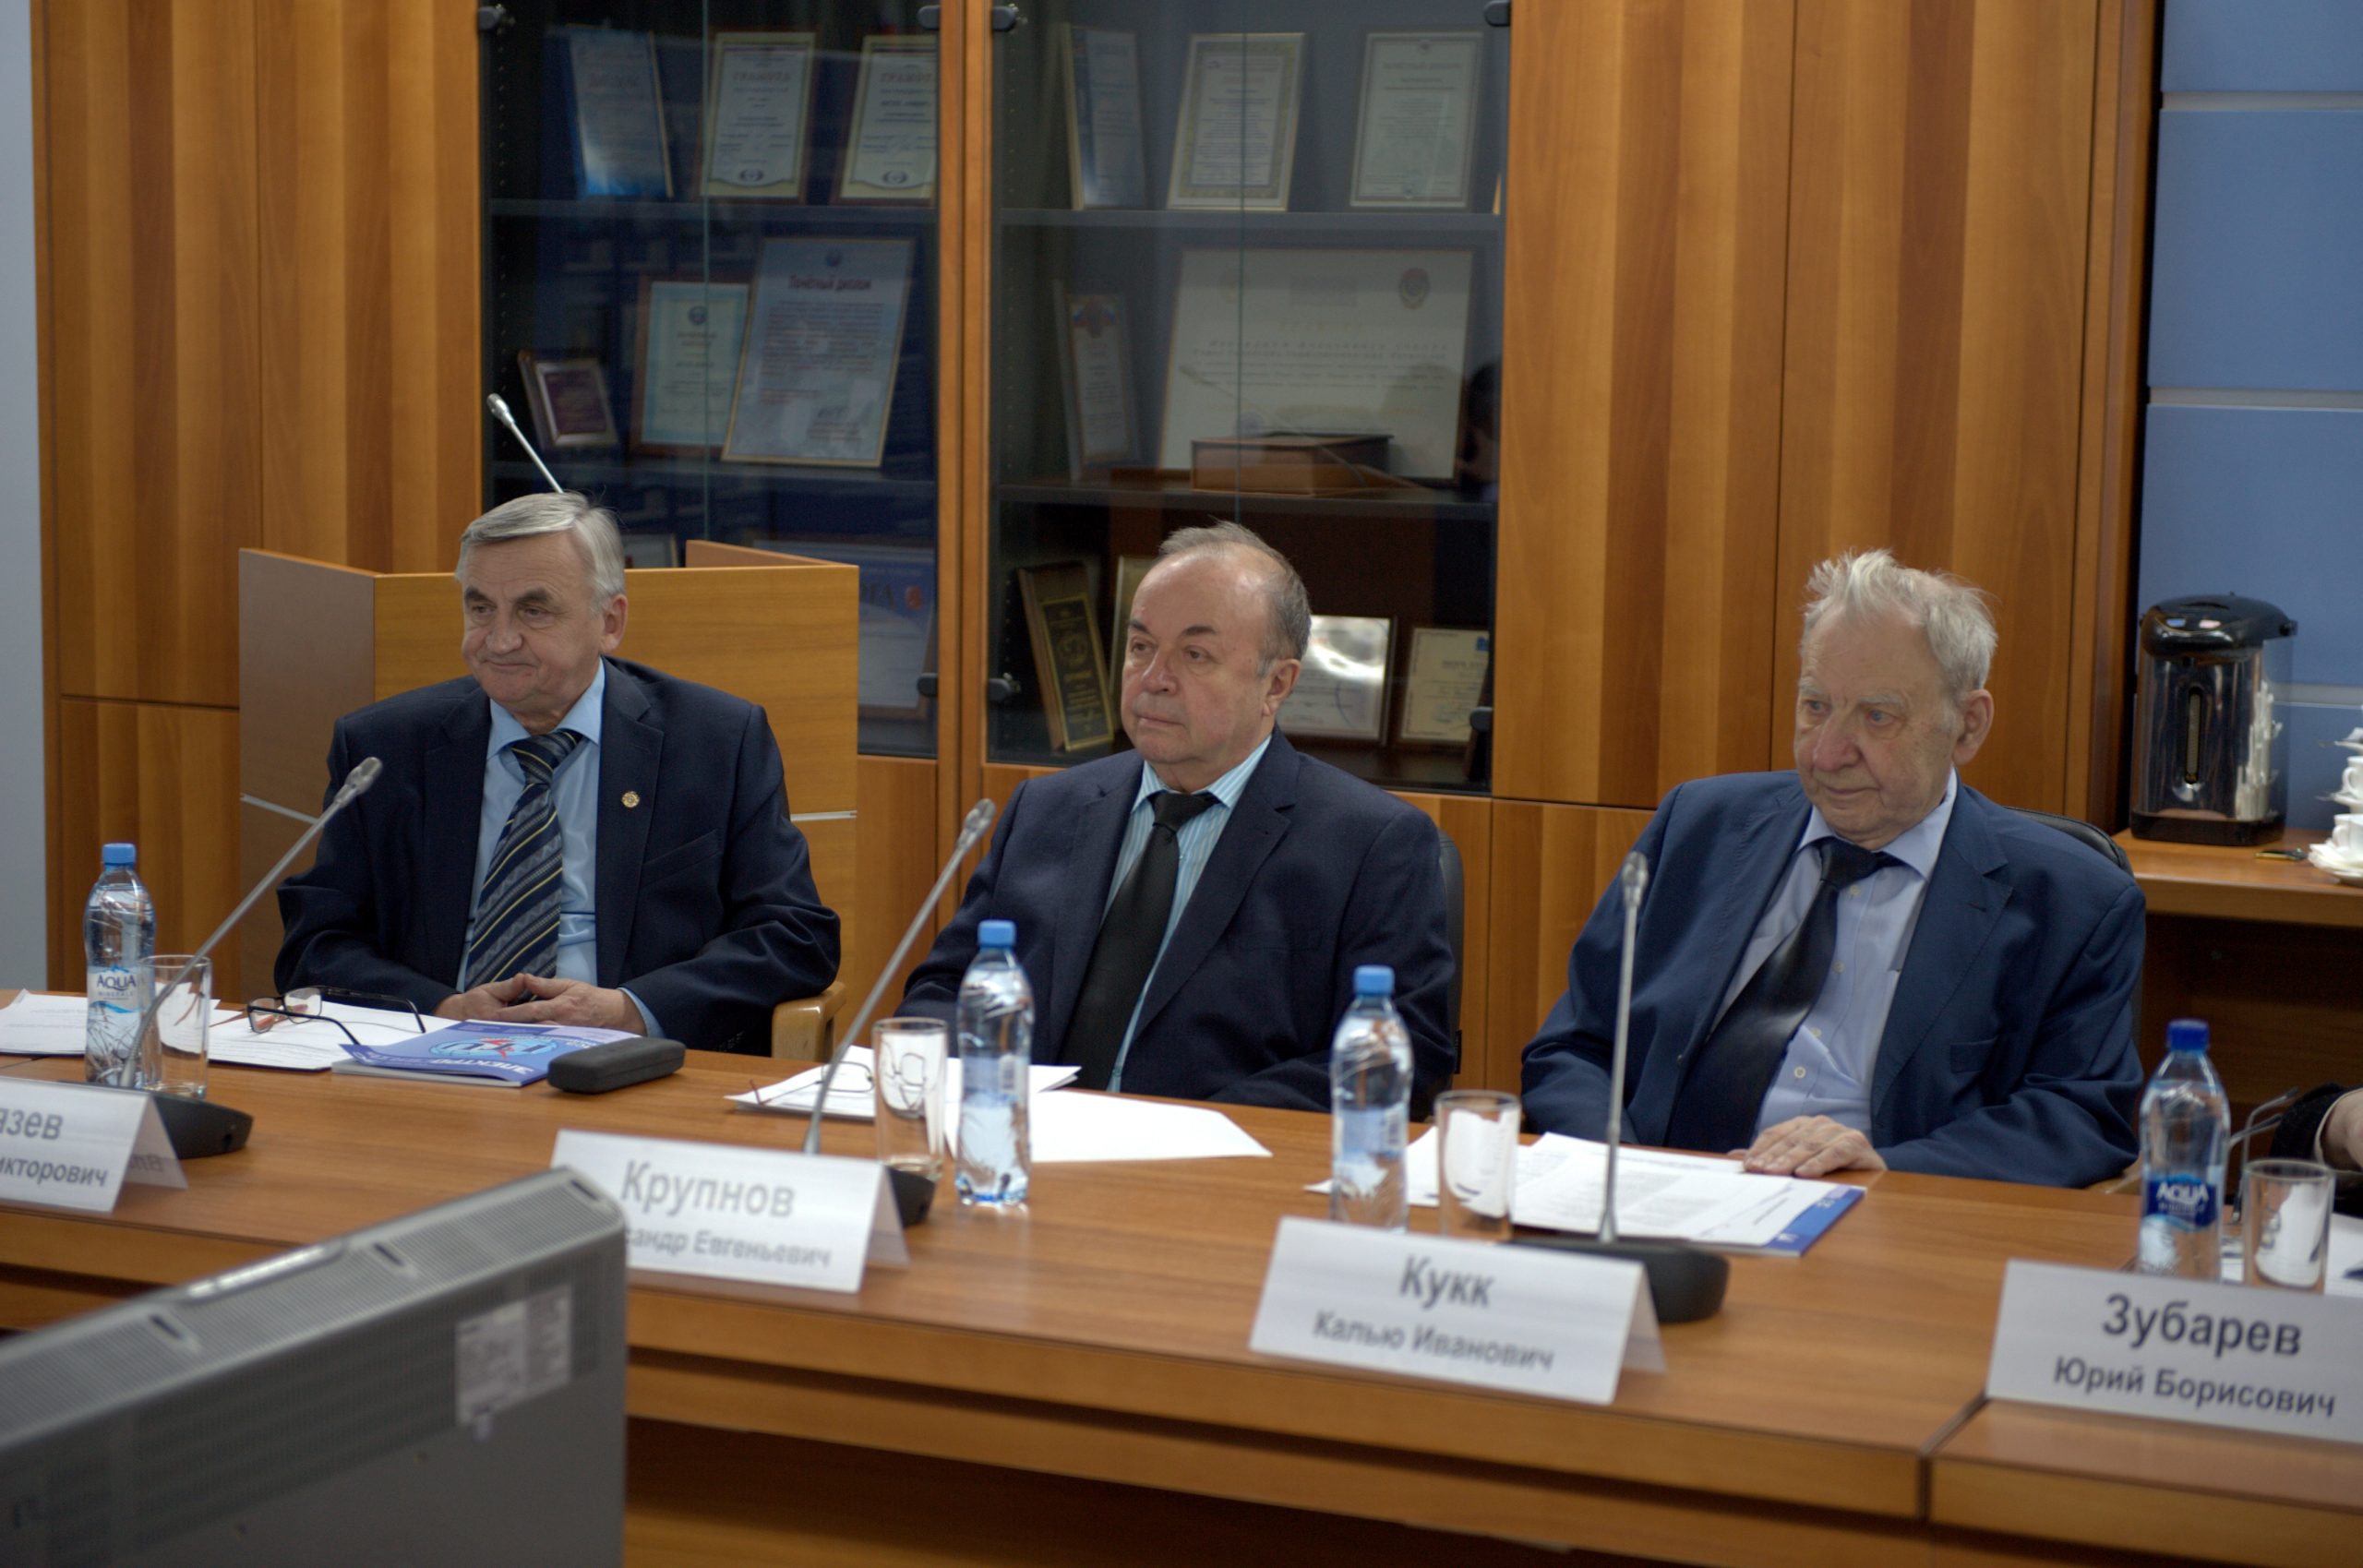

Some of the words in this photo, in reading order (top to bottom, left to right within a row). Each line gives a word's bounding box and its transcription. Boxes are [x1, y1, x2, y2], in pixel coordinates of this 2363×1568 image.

[97, 975, 137, 991] AQUA
[621, 1160, 795, 1216] Крупнов
[2156, 1181, 2210, 1204] AQUA
[624, 1227, 689, 1256] андр
[694, 1229, 832, 1267] Евгеньевич
[1399, 1255, 1495, 1310] Кукк
[1411, 1324, 1554, 1371] Иванович
[2103, 1294, 2302, 1359] Зубарев
[2055, 1357, 2144, 1395] Юрий
[2154, 1369, 2336, 1418] Борисович
